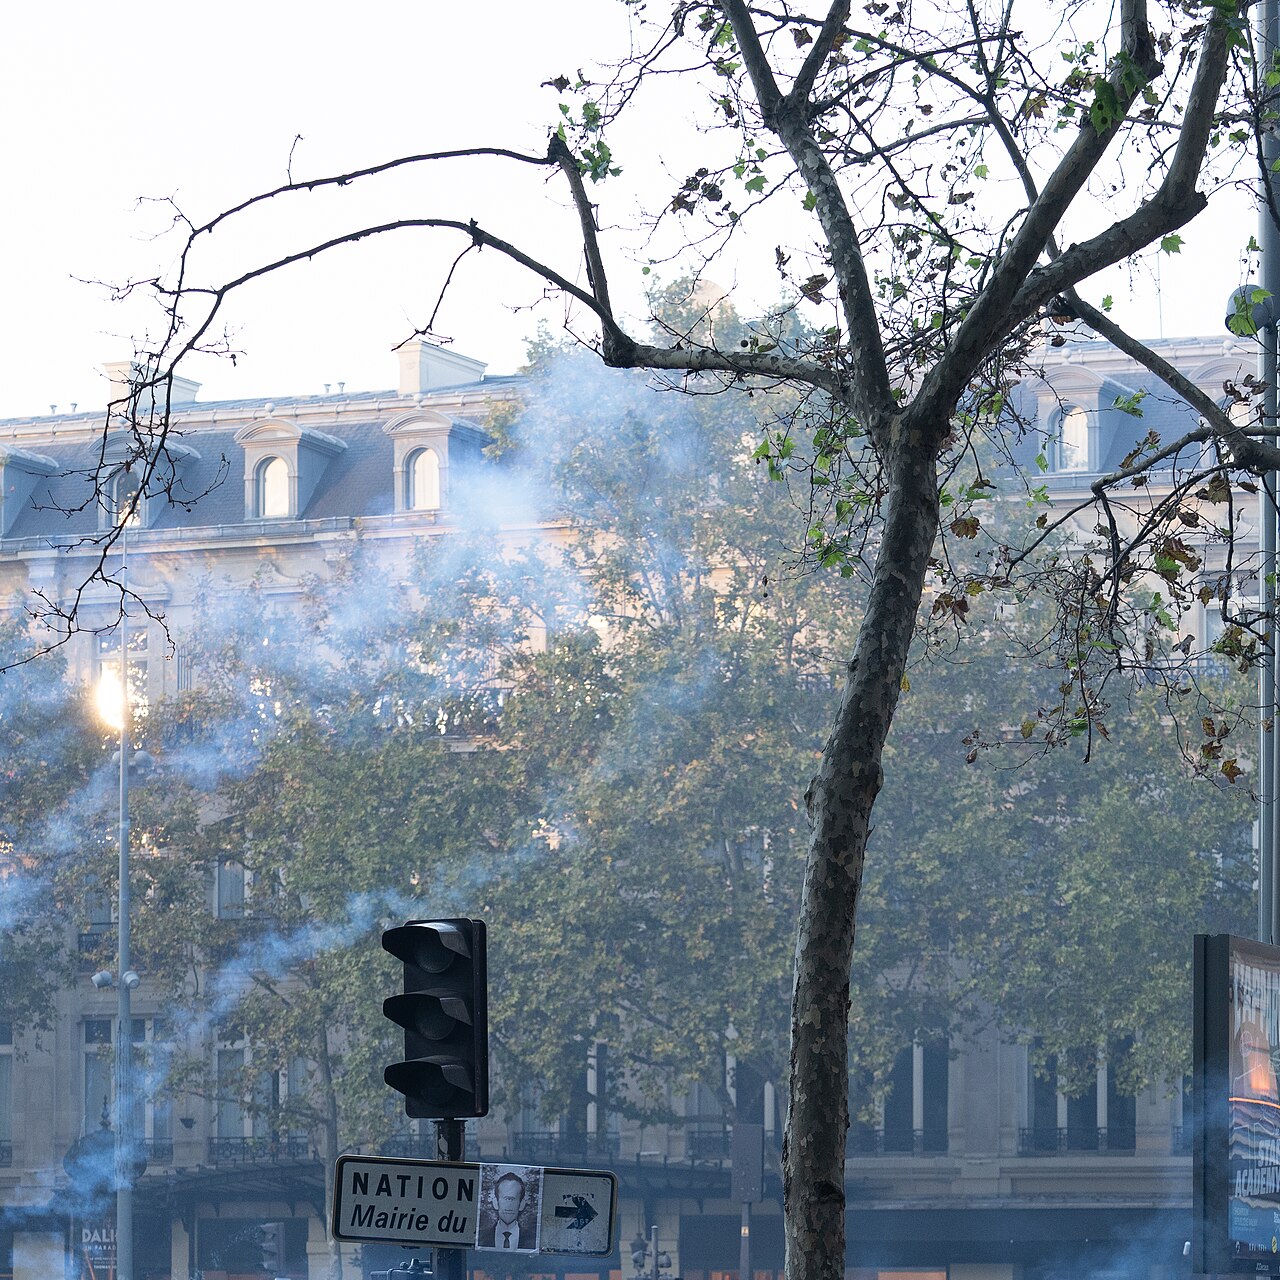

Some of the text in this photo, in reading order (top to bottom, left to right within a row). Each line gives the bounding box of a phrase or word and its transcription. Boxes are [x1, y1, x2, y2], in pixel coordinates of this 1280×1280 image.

[352, 1171, 474, 1202] NATION
[350, 1203, 429, 1231] Mairie
[438, 1209, 467, 1234] du
[82, 1228, 117, 1243] DALI
